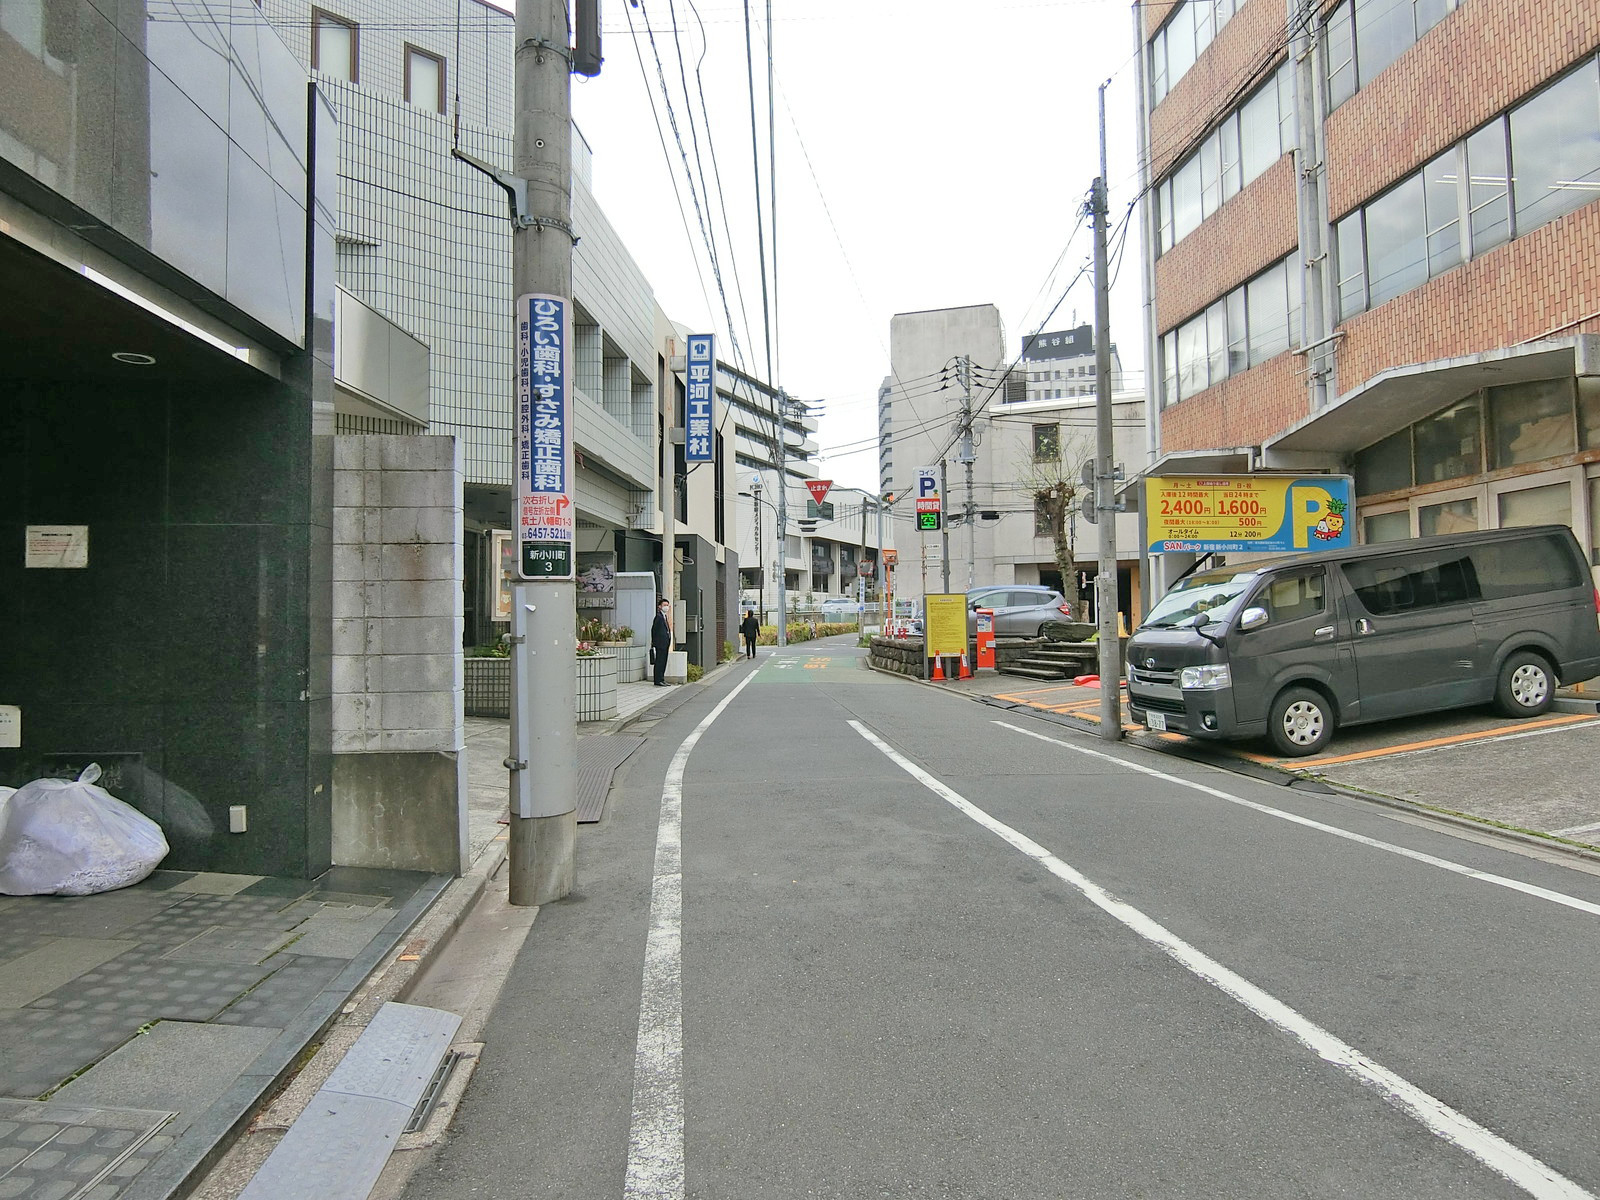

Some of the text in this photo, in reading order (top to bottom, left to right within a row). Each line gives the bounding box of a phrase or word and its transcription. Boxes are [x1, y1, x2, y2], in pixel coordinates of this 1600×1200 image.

[1038, 335, 1075, 349] 熊谷組
[690, 365, 711, 455] 平河工業社
[919, 477, 936, 497] P
[523, 496, 555, 505] 次右折し
[917, 501, 940, 511] 時間貸
[920, 513, 937, 529] 空
[1291, 486, 1333, 548] P
[529, 550, 566, 560] 新小川町
[545, 562, 553, 572] 3
